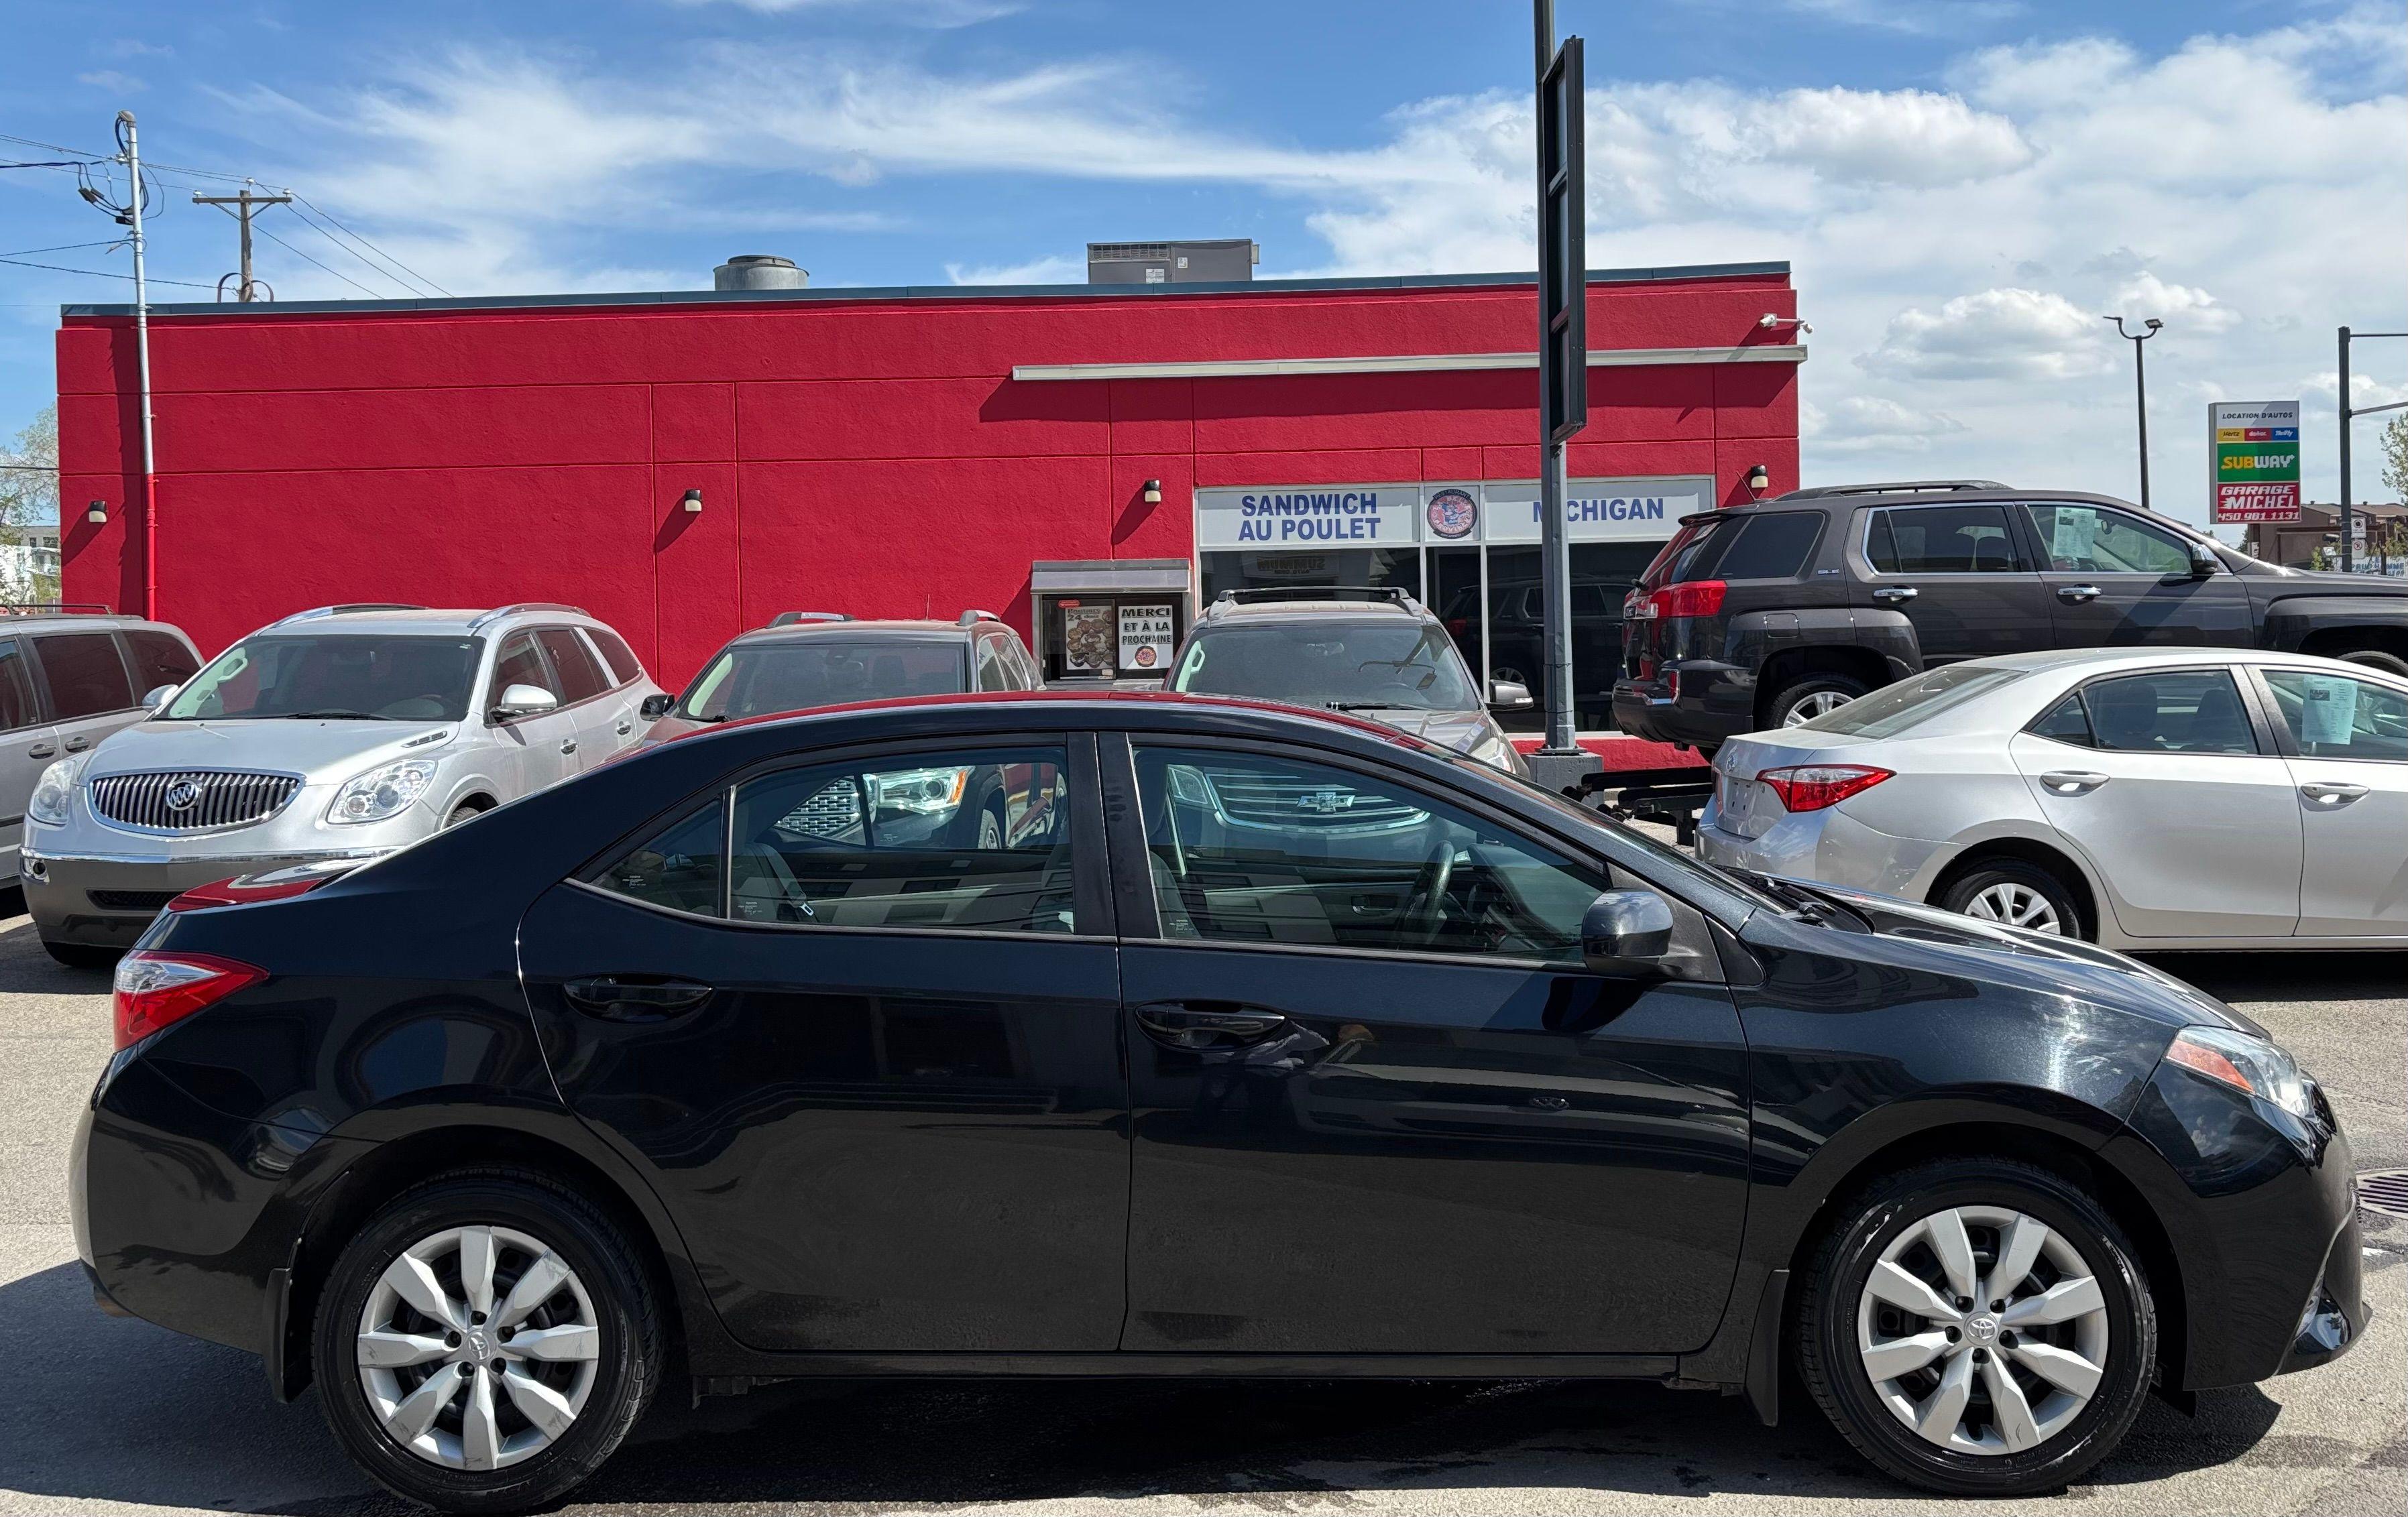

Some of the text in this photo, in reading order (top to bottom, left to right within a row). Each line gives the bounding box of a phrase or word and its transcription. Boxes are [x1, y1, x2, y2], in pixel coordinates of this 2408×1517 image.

[2221, 454, 2295, 470] SUBWAY
[2221, 485, 2296, 495] GARAGE
[1241, 493, 1377, 516] SANDWICH
[2222, 495, 2299, 509] MICHEL
[2218, 511, 2300, 522] 450.981.1131
[1239, 518, 1381, 541] AU POULET
[1121, 607, 1171, 619] MERCI
[1124, 620, 1169, 632] ET À LA
[1122, 634, 1172, 645] PROCHAINE
